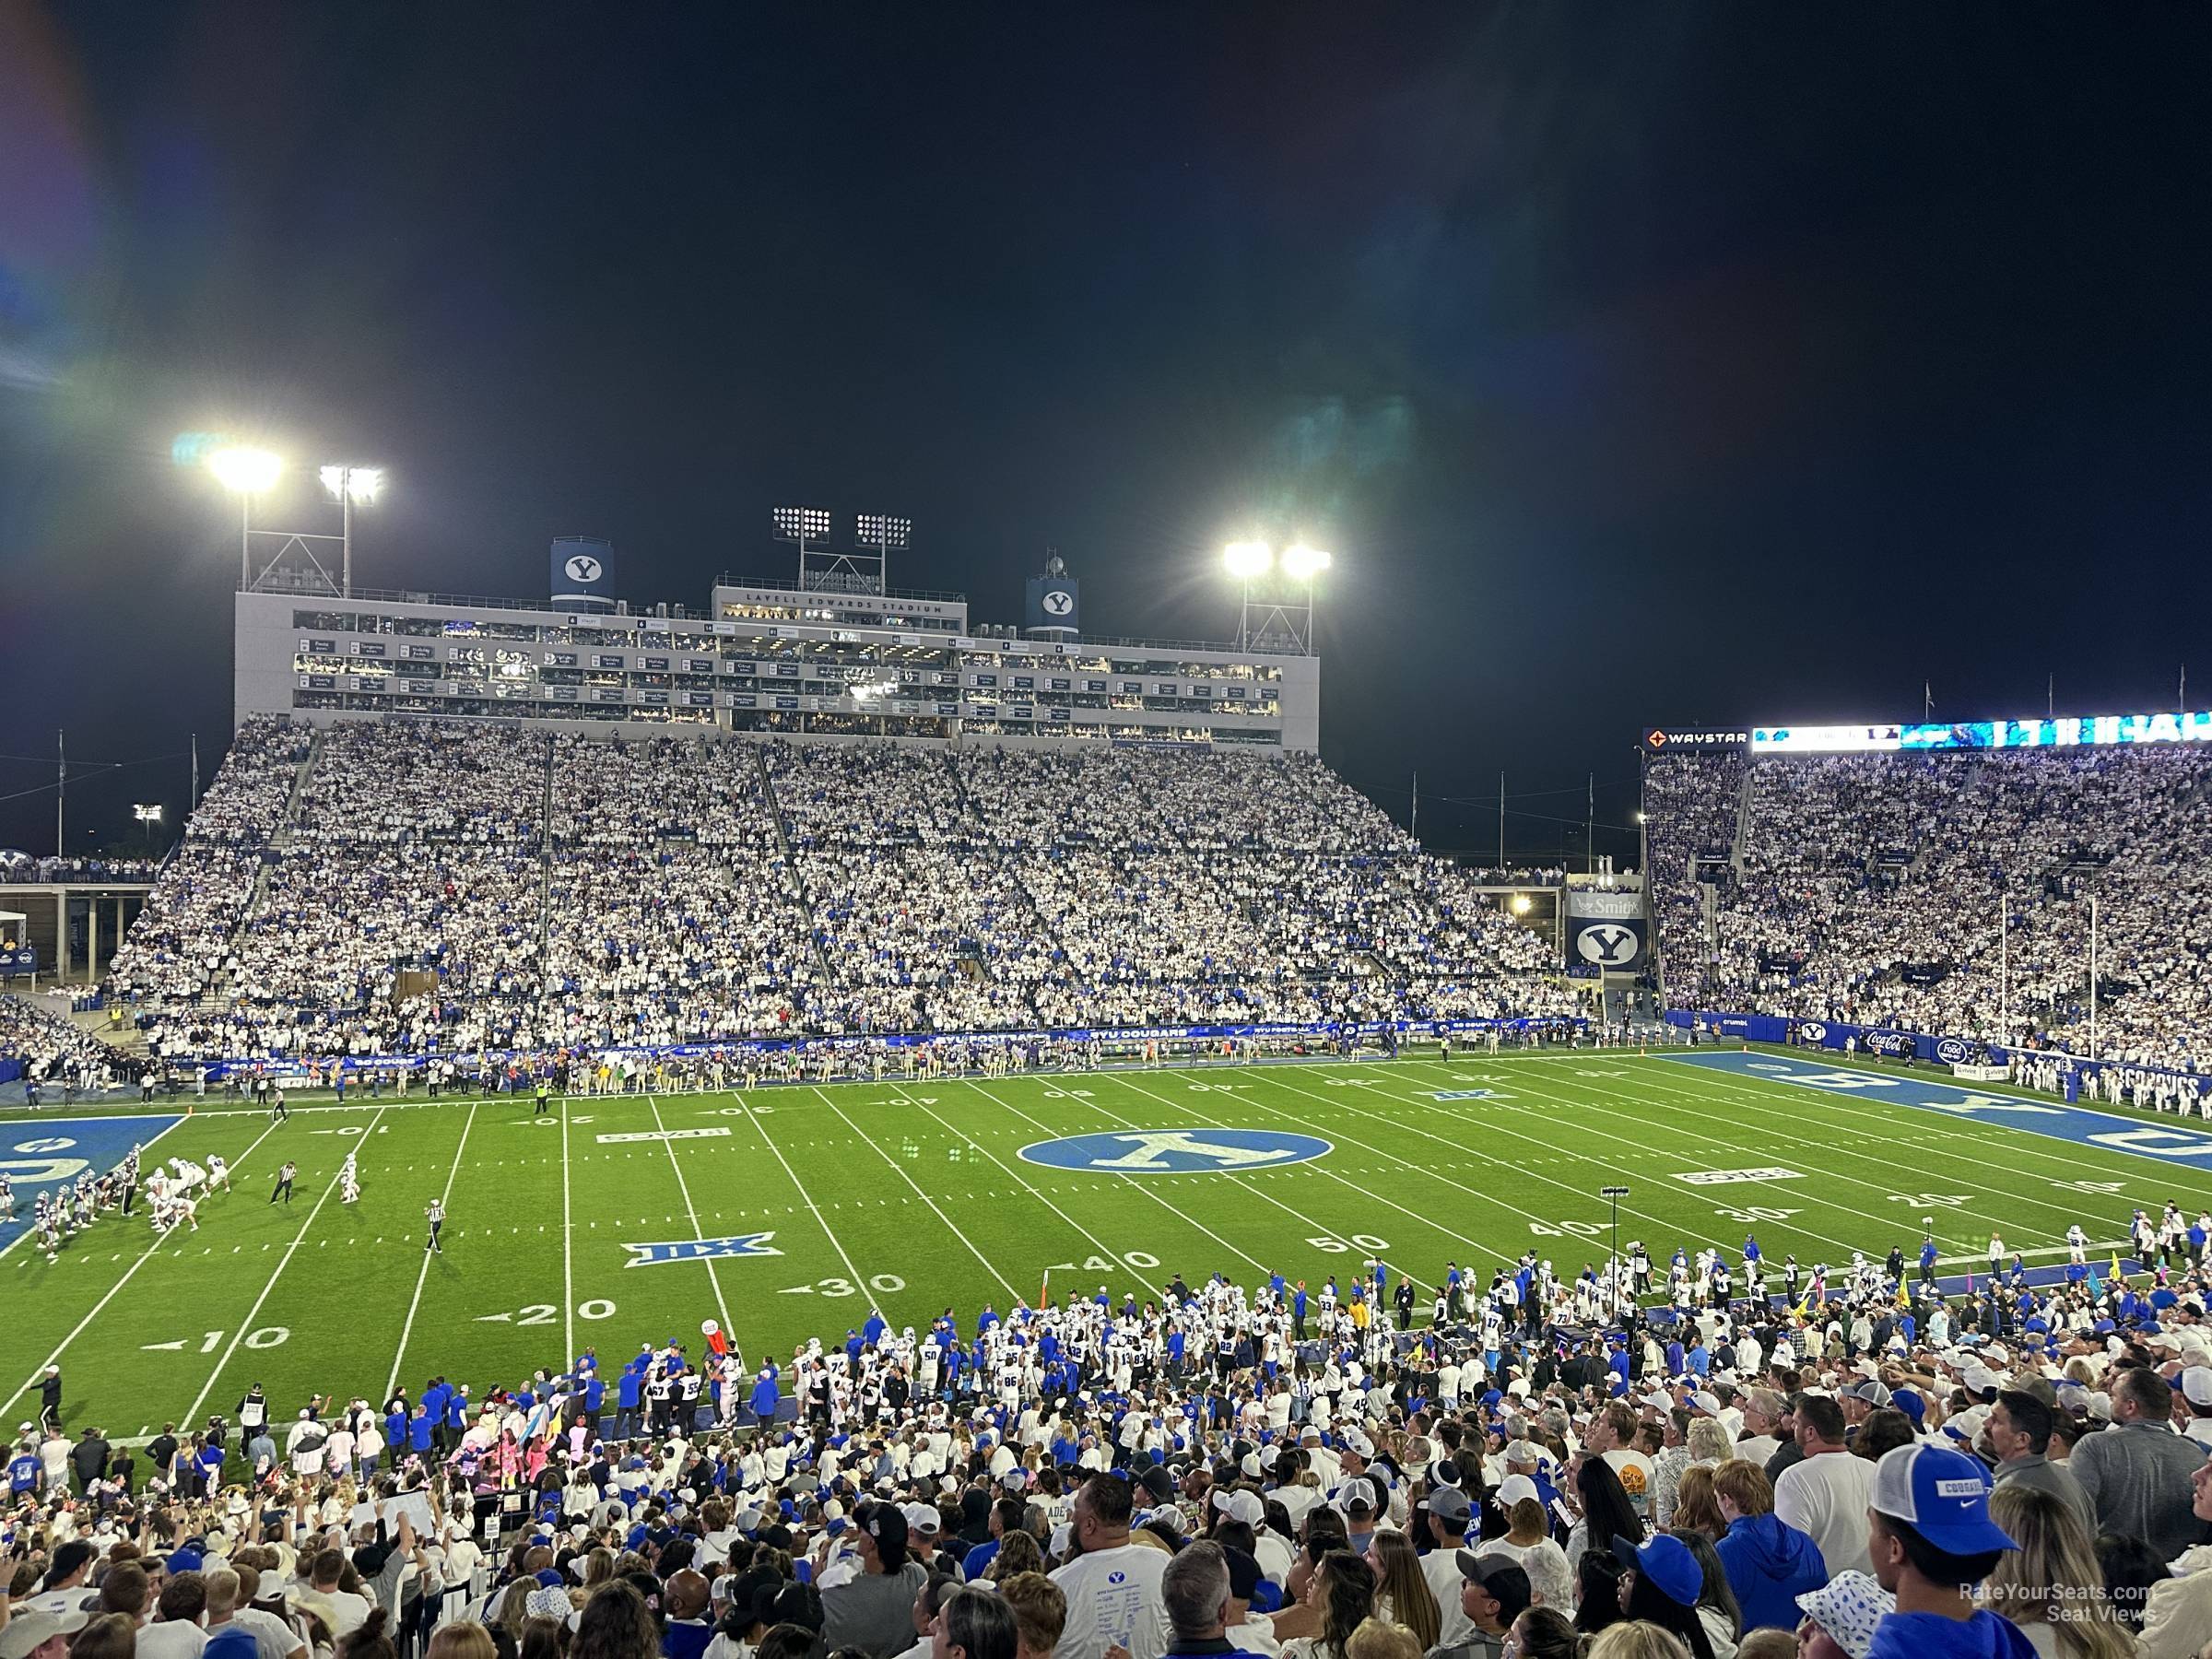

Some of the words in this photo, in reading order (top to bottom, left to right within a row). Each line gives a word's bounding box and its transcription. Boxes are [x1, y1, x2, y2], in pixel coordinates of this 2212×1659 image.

[571, 559, 596, 579] Y
[747, 594, 797, 603] LAVELL
[808, 598, 872, 608] EDWARDS
[882, 603, 941, 613] STADIUM
[1048, 594, 1069, 612] Y
[1669, 733, 1747, 744] WAYSTAR
[1595, 898, 1639, 914] Smith's
[1586, 929, 1630, 960] Y
[1090, 1030, 1118, 1039] BYU
[1121, 1029, 1188, 1038] COUGARS
[1806, 1023, 1820, 1038] Y
[1943, 1043, 1961, 1055] Food
[1089, 1132, 1298, 1168] Y
[2050, 1180, 2120, 1194] 10
[1886, 1193, 1964, 1208] 20
[1714, 1206, 1789, 1223] 30
[1528, 1220, 1602, 1237] 40
[1305, 1234, 1391, 1253] 50
[1076, 1251, 1162, 1272] 40
[818, 1273, 907, 1298] 30
[516, 1298, 617, 1326] 20
[1321, 1301, 1332, 1312] 33
[1487, 1317, 1498, 1329] 17
[1557, 1313, 1568, 1324] 73
[200, 1326, 292, 1354] 10
[1220, 1341, 1232, 1352] 82
[924, 1351, 937, 1360] 50
[1071, 1346, 1082, 1358] 32
[1121, 1353, 1130, 1365] 13
[1134, 1354, 1145, 1365] 83
[801, 1360, 811, 1374] 80
[688, 1382, 699, 1393] 55
[1005, 1376, 1017, 1387] 86
[653, 1386, 665, 1397] 67
